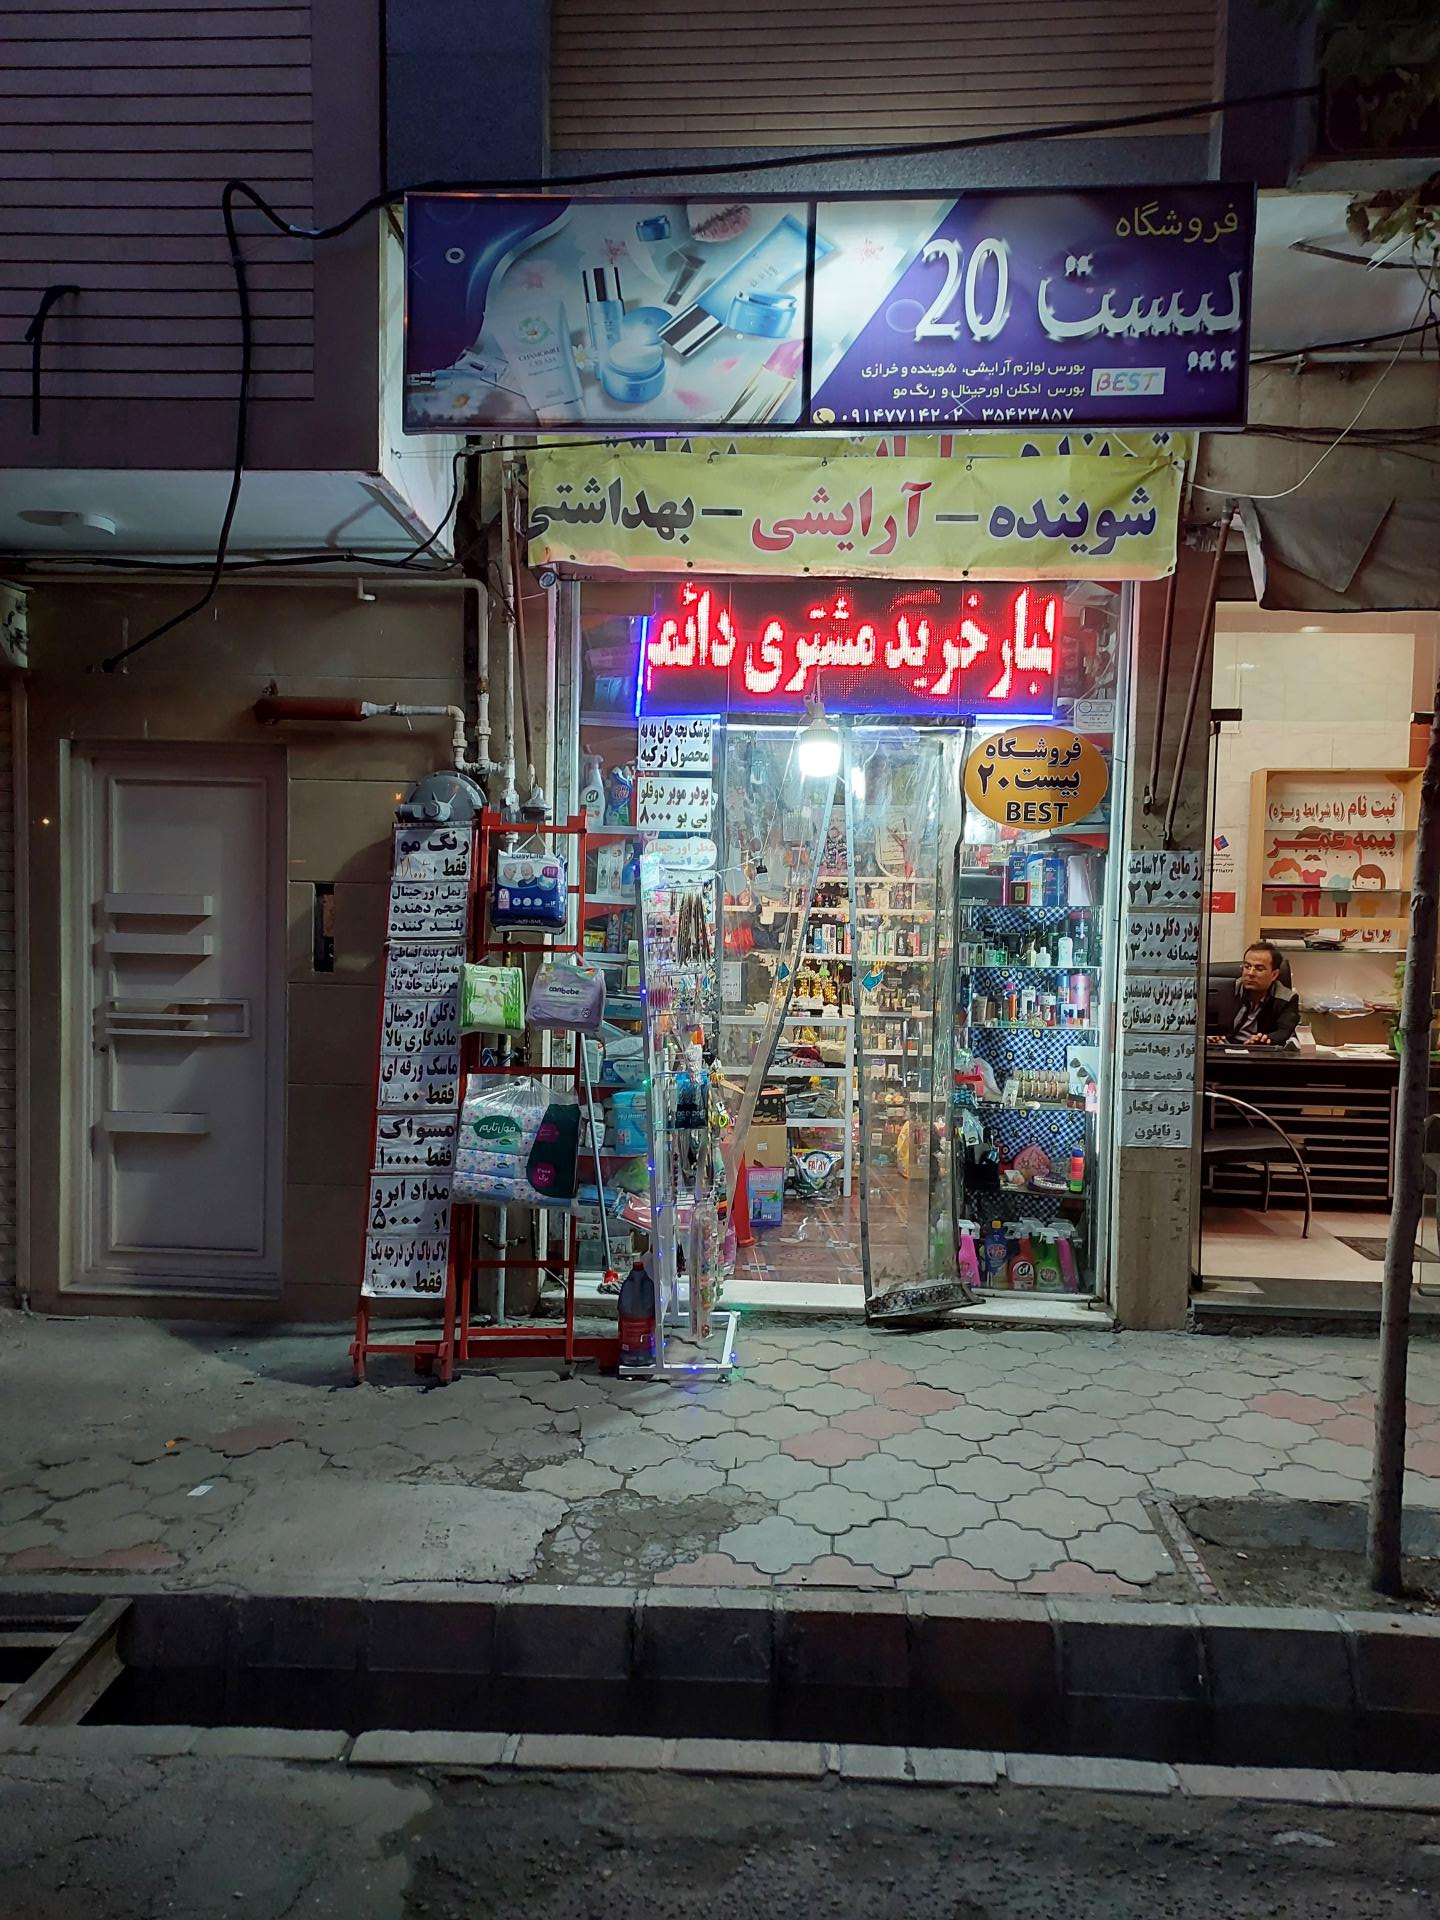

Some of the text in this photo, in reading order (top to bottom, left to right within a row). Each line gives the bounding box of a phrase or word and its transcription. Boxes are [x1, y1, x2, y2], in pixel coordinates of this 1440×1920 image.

[1116, 201, 1239, 243] فروشگاه
[914, 237, 1012, 342] 20
[861, 362, 899, 378] خرازی
[910, 362, 957, 378] شوینده
[1013, 361, 1046, 376] لوازم
[1048, 363, 1086, 376] بورس
[893, 387, 908, 399] مو
[909, 383, 936, 399] رنگ
[951, 383, 1004, 399] اورجینال
[1006, 383, 1041, 398] ادکلن
[1047, 385, 1085, 398] بورس
[1096, 370, 1160, 393] BEST
[981, 407, 1074, 423] ۳۵۴۲۳۸۵۷
[527, 476, 1157, 555] شوینده آرایشی بهداشتی
[745, 596, 877, 693] مشتری
[885, 593, 989, 695] خرید
[657, 719, 673, 744] جان
[674, 724, 688, 745] بچه
[689, 720, 710, 745] پوشک
[640, 744, 710, 768] محصول ترکیه
[984, 736, 1083, 768] فروشگاه
[640, 780, 665, 804] دوقلو
[976, 763, 1081, 798] بیست ۲۰
[666, 786, 687, 806] موبر
[688, 785, 709, 806] پودر
[640, 805, 708, 829] بی بو ۸۰۰۰
[1005, 801, 1070, 823] BEST
[1302, 801, 1331, 823] شرایط
[1347, 794, 1368, 825] نام
[1370, 792, 1398, 824] ثبت
[400, 830, 470, 856] رنگ مو
[1352, 831, 1396, 857] بیمه
[441, 855, 468, 877] فقط
[1169, 855, 1191, 881] مایع
[1191, 856, 1203, 881] رژ
[391, 885, 468, 901] ریمل اورجینال
[1127, 880, 1202, 905] ۲۳۰۰۰
[392, 902, 464, 918] حجم دهنده
[390, 918, 426, 932] کننده
[1130, 920, 1154, 942] درجه
[1156, 916, 1181, 943] دکلره
[390, 945, 421, 962] اقساطی
[422, 945, 439, 961] بدنه
[1166, 943, 1199, 967] پیمانه
[390, 979, 403, 993] دار
[404, 976, 423, 991] خانه
[548, 985, 580, 995] canbebe
[384, 1002, 456, 1029] دکلن اورجینال
[385, 1028, 457, 1053] ماندگاری بالا
[1123, 1042, 1196, 1059] نوار بهداشتی
[382, 1053, 458, 1083] ماسک ورقه ای
[1121, 1070, 1151, 1081] عمده
[1153, 1068, 1183, 1084] قیمت
[425, 1081, 455, 1105] فقط
[1125, 1099, 1191, 1116] ظروف یکبار
[379, 1117, 455, 1146] مسواک
[1134, 1123, 1171, 1140] نایلون
[379, 1143, 452, 1169] فقط ۱۰۰۰۰
[371, 1178, 450, 1209] مداد ابرو
[371, 1207, 447, 1232] از ۵۰۰۰
[370, 1240, 447, 1268] لاک پاک کن درجه یک
[412, 1268, 442, 1294] فقط
